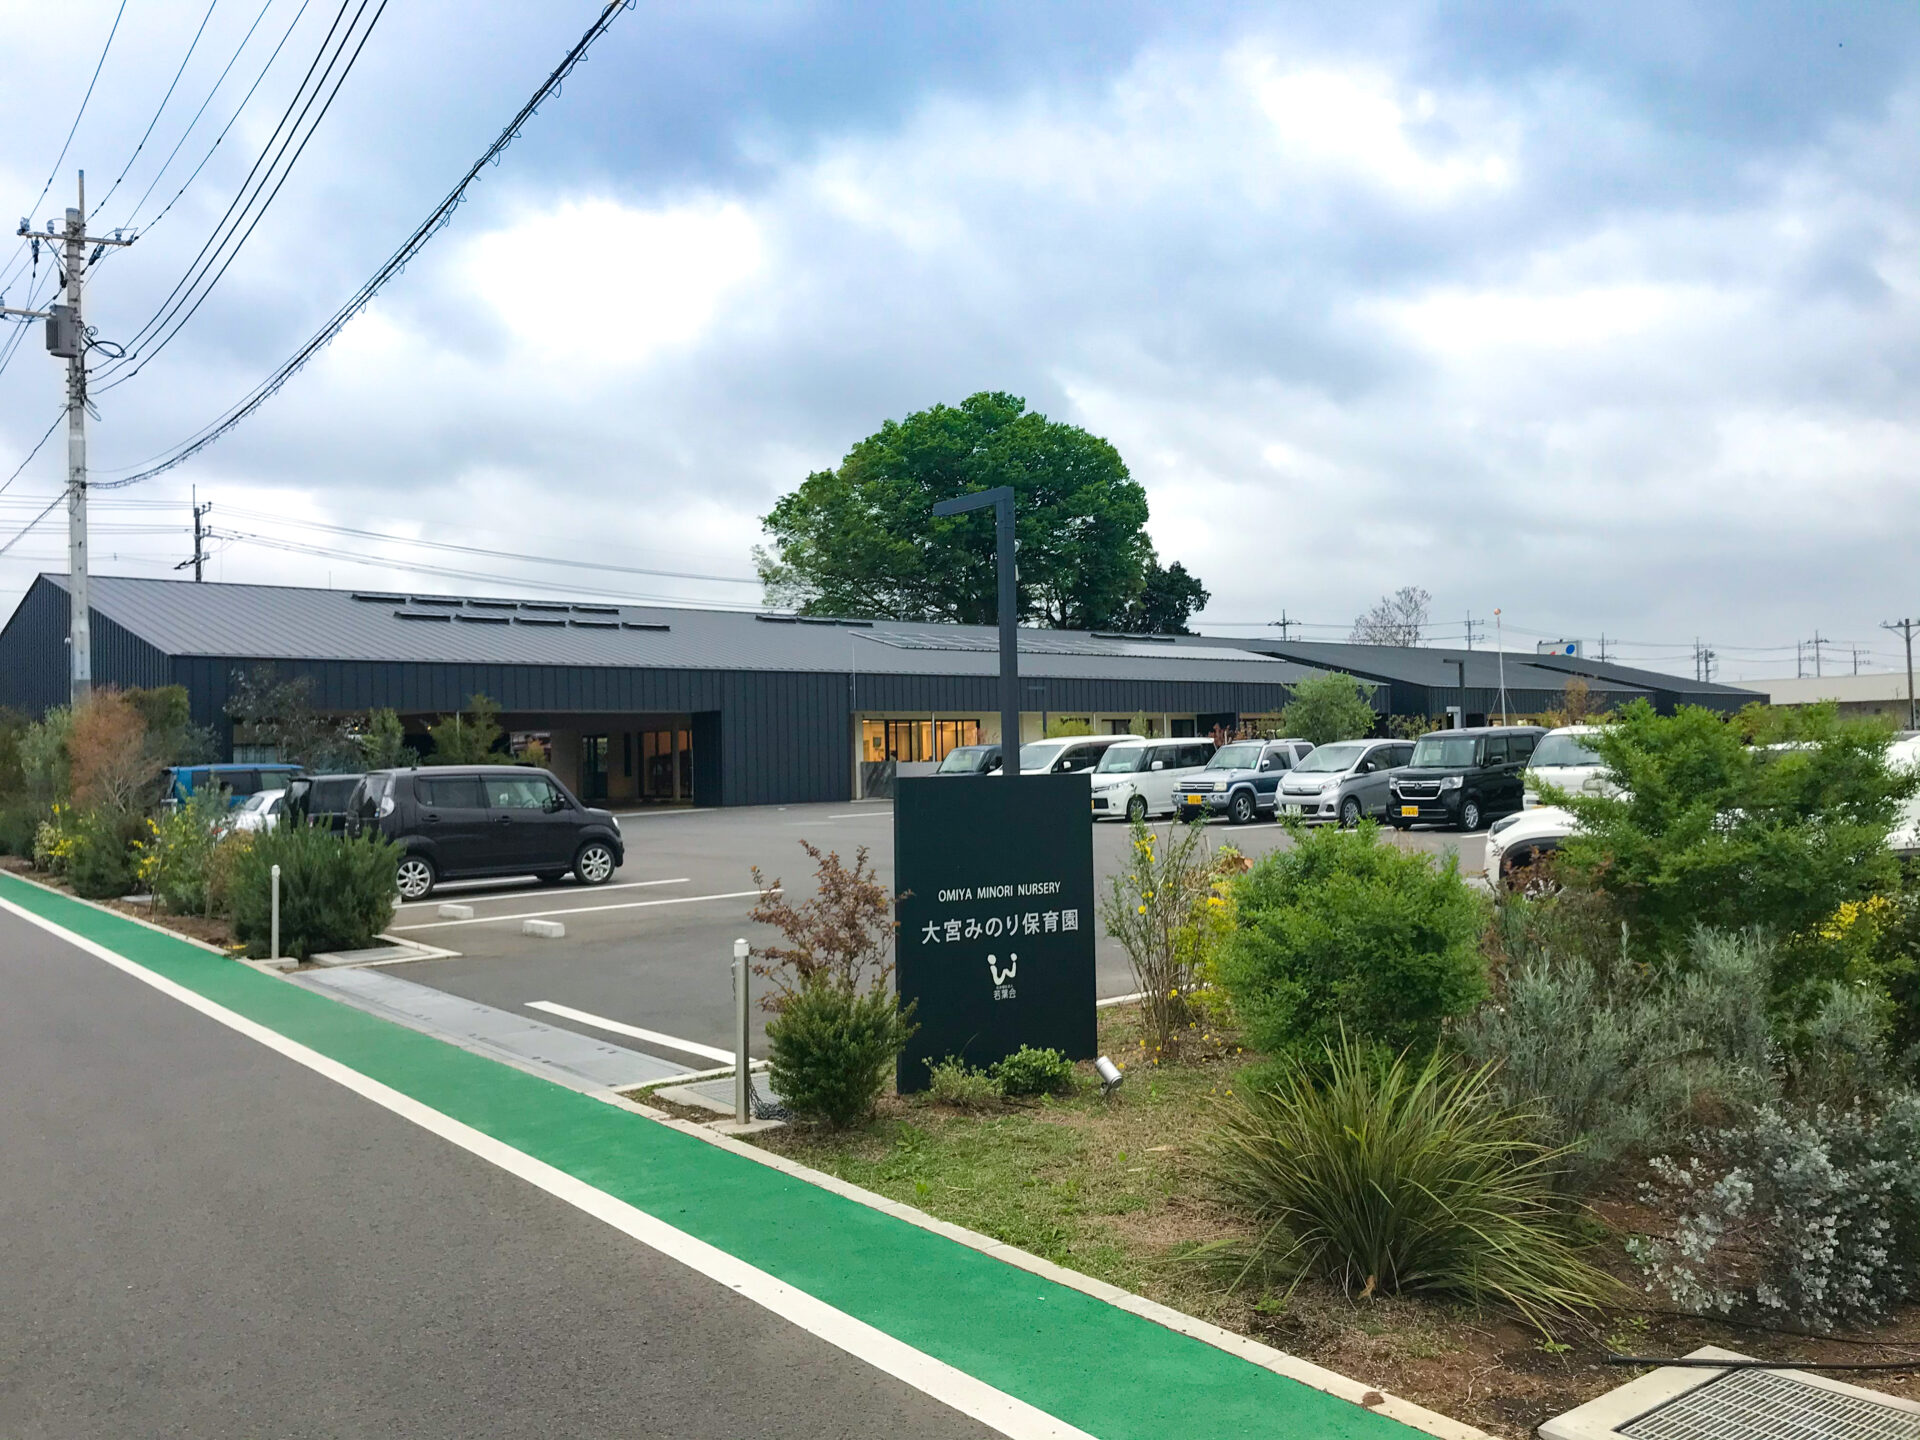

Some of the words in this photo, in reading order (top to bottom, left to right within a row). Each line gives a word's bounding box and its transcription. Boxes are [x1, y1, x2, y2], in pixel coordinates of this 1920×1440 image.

[938, 889, 973, 902] OMIYA
[977, 885, 1014, 899] MINORI
[1017, 881, 1061, 896] NURSERY
[921, 909, 1079, 945] 大宮みのり保育園
